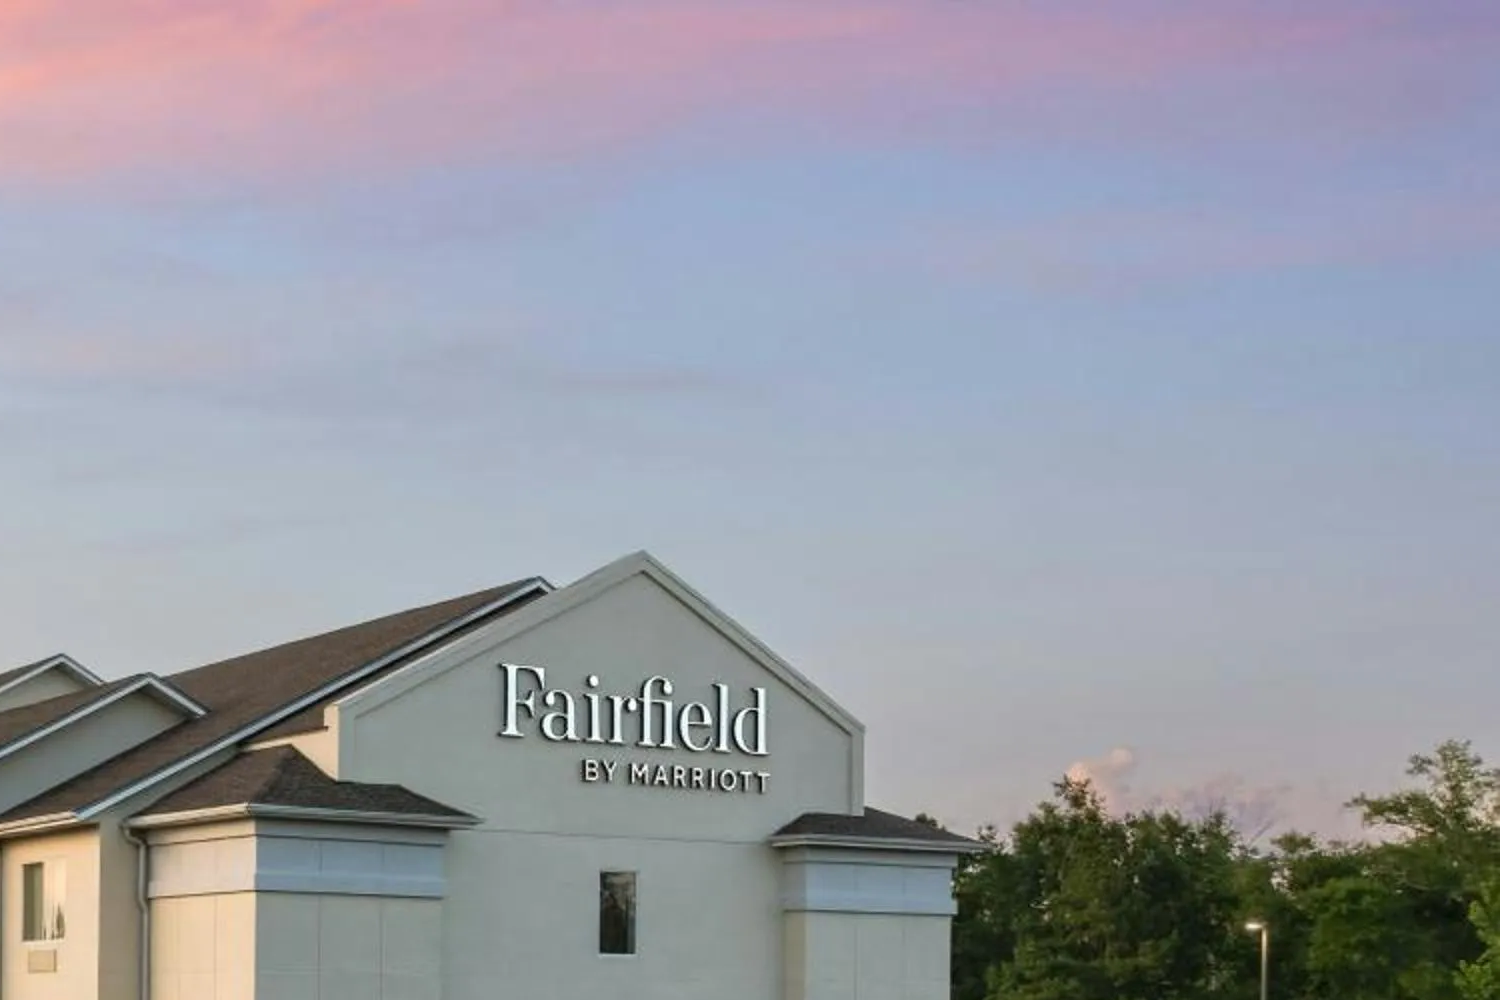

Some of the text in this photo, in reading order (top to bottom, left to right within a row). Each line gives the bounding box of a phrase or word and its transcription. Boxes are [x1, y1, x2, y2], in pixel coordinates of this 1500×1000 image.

[499, 662, 770, 756] Fairfield
[582, 759, 771, 793] BY MARRIOTT
